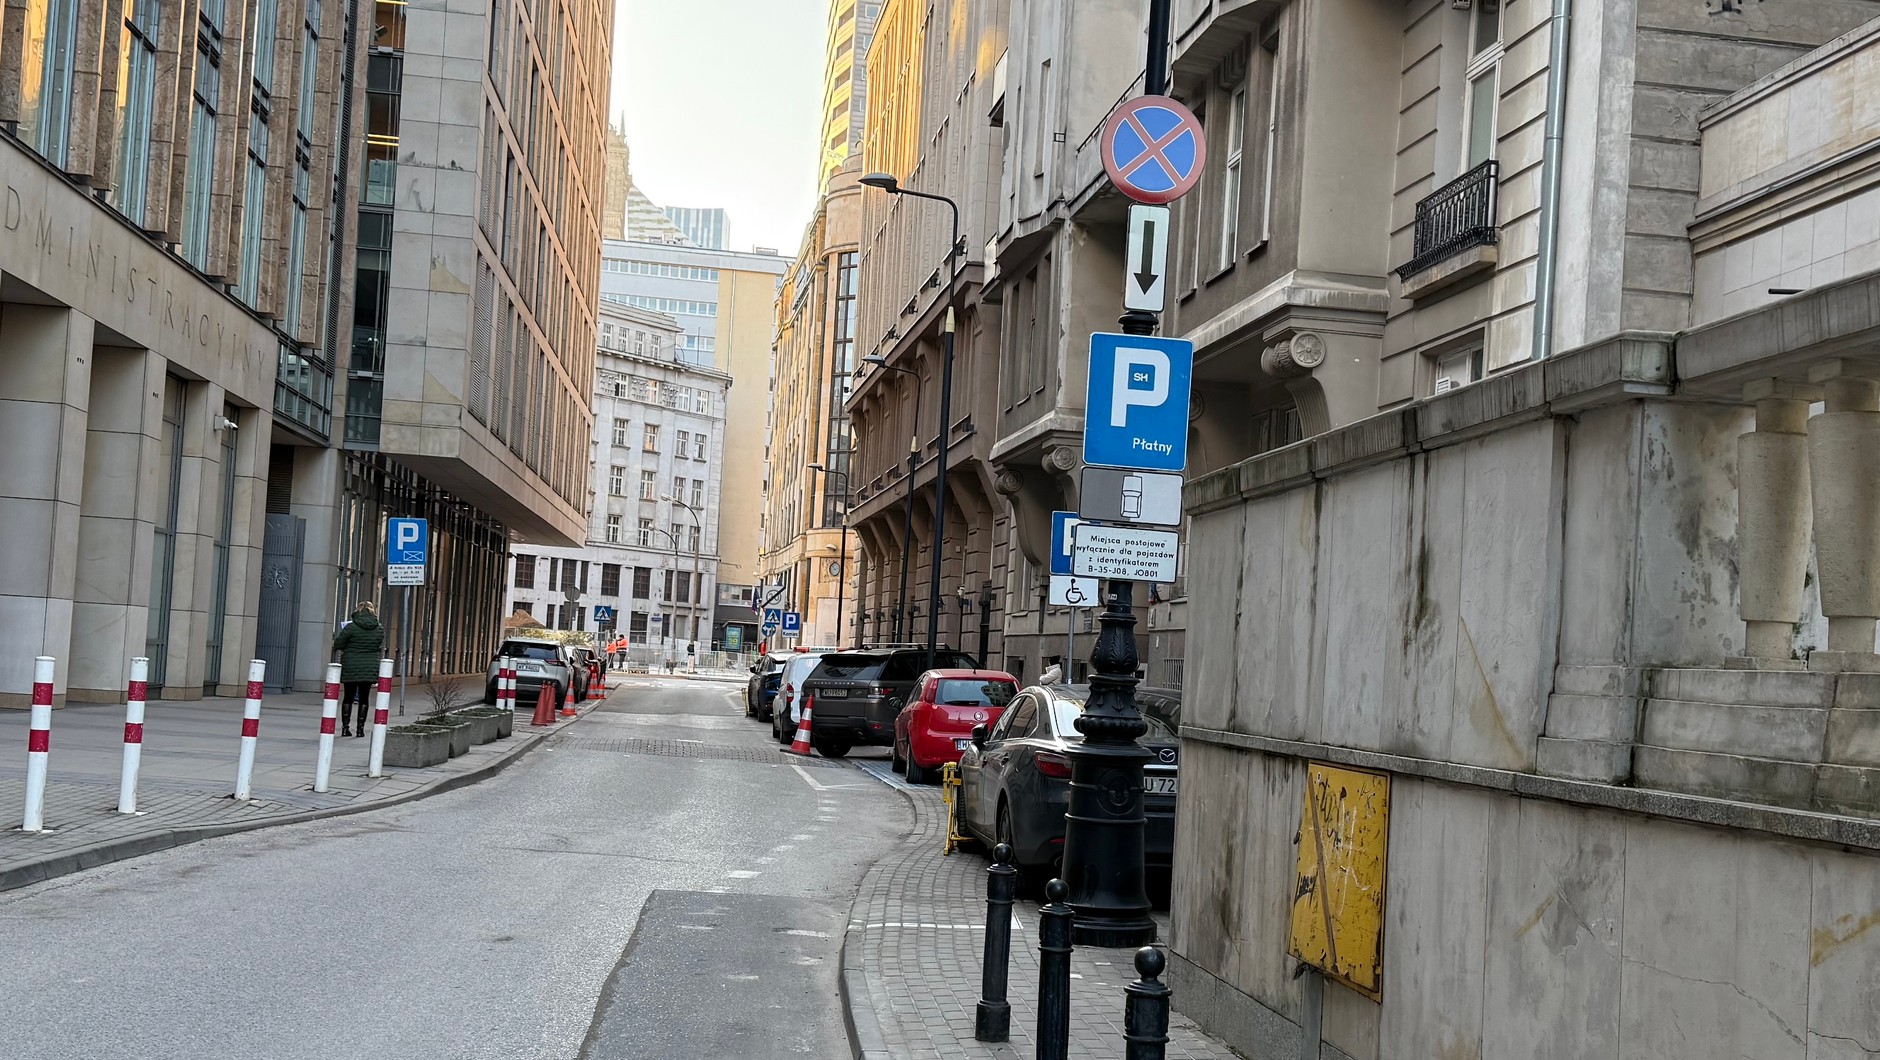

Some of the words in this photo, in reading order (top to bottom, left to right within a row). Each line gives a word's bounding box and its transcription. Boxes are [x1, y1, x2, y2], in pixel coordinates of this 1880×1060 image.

[1111, 347, 1170, 427] P
[1132, 437, 1173, 456] Płatny
[397, 522, 419, 550] P
[1090, 535, 1121, 545] Miejsca
[1125, 539, 1166, 549] postojowe
[1076, 545, 1115, 554] wyłącznie
[1119, 547, 1132, 555] dla
[1136, 550, 1175, 559] pojazdów
[1096, 556, 1160, 568] identyfikatorem
[785, 614, 797, 628] P
